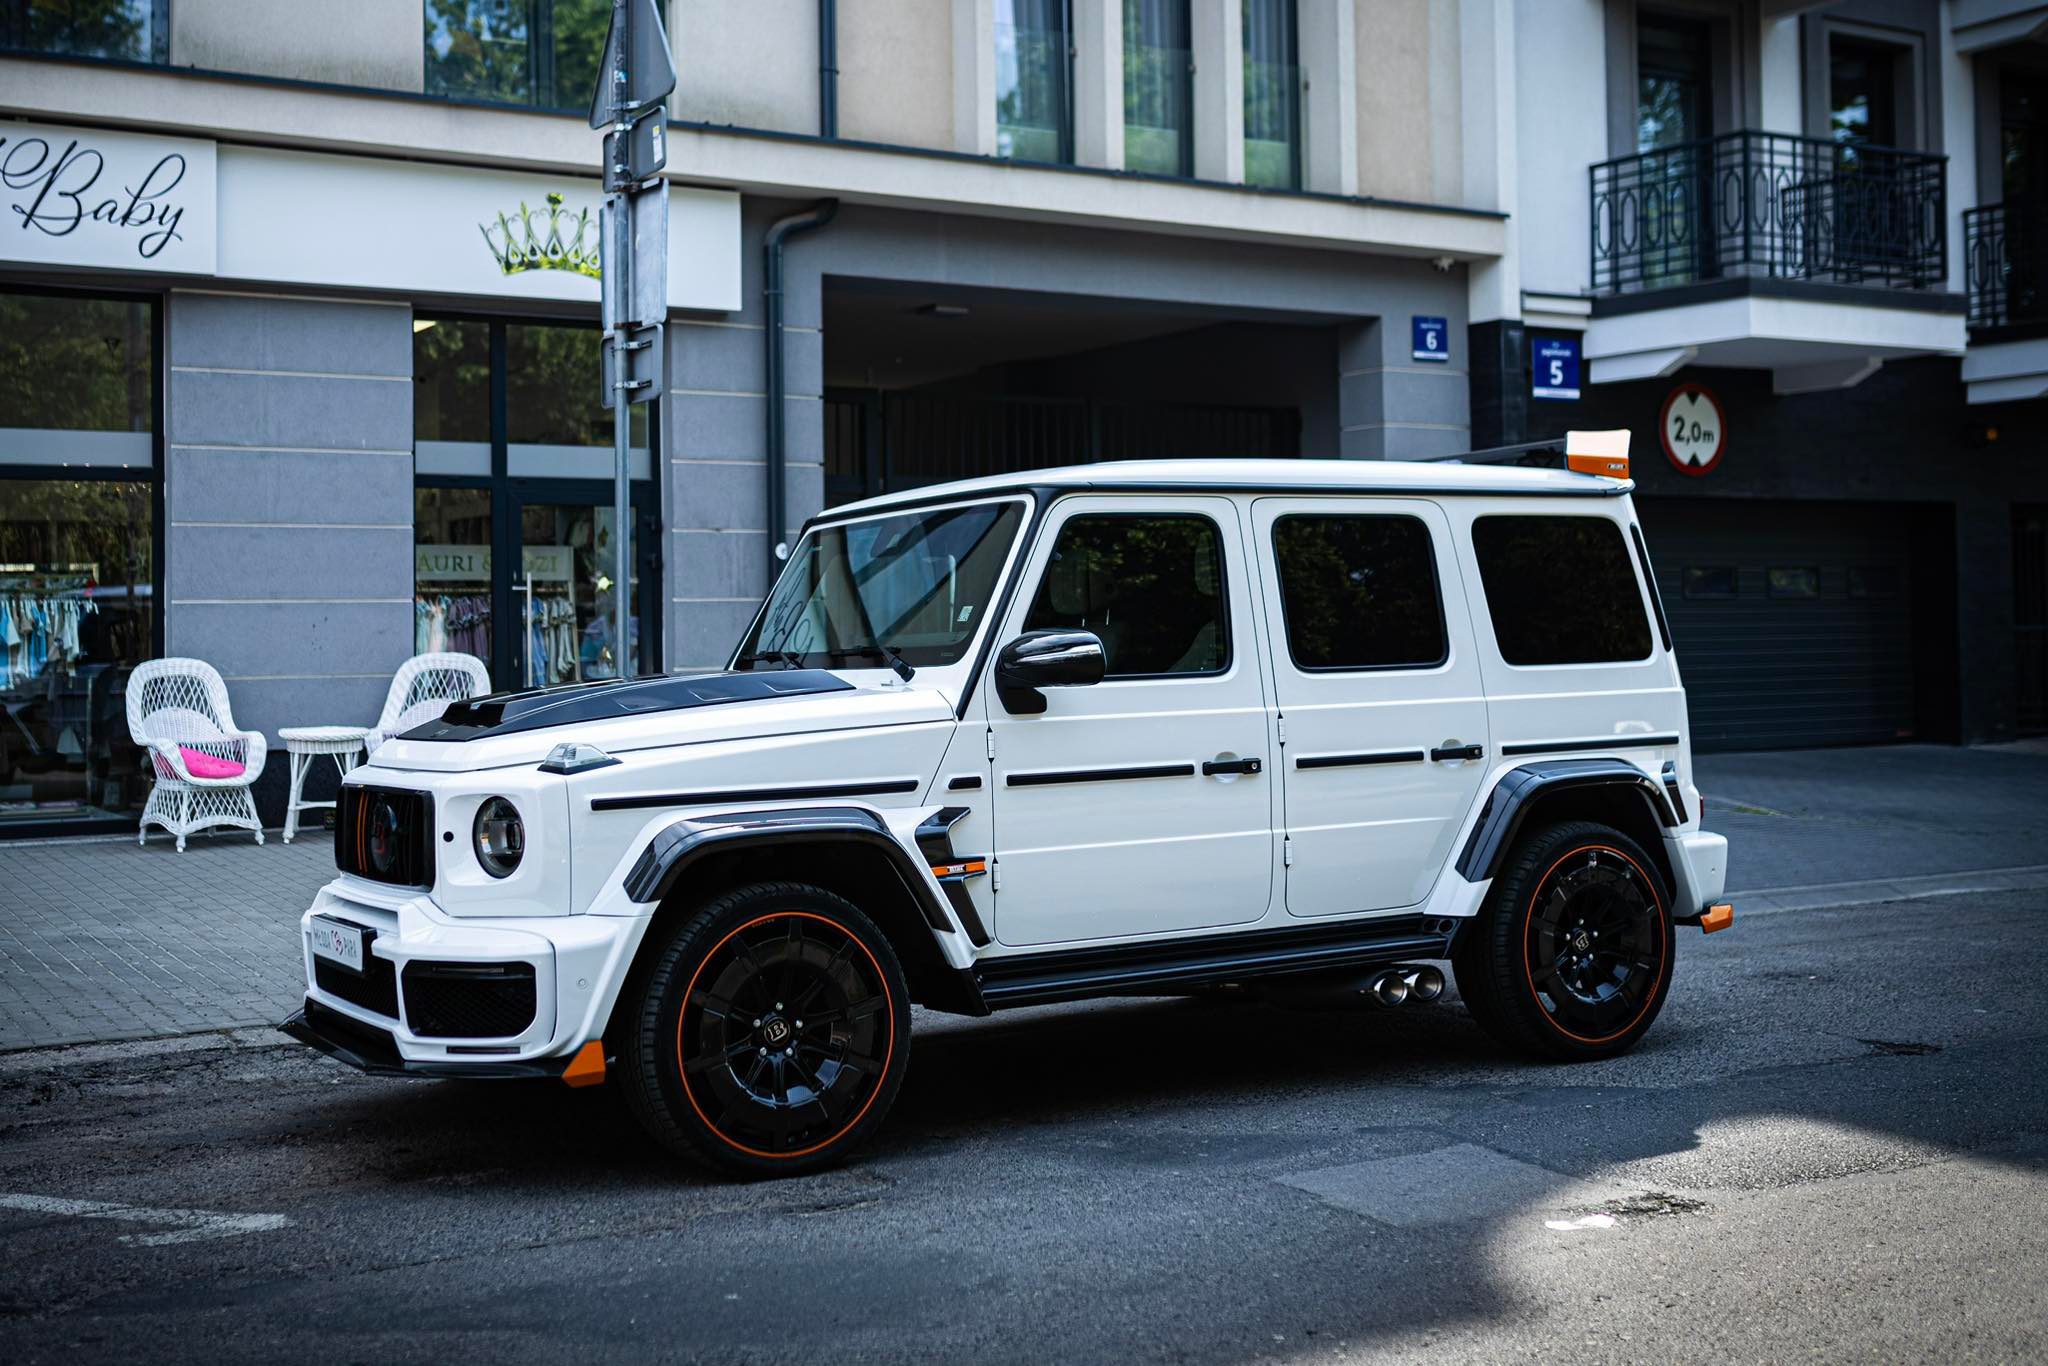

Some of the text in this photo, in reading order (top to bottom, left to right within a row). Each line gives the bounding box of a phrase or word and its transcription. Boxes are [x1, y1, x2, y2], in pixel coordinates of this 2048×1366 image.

[2, 138, 186, 258] Baby
[1426, 331, 1437, 350] 6
[1550, 360, 1563, 385] 5
